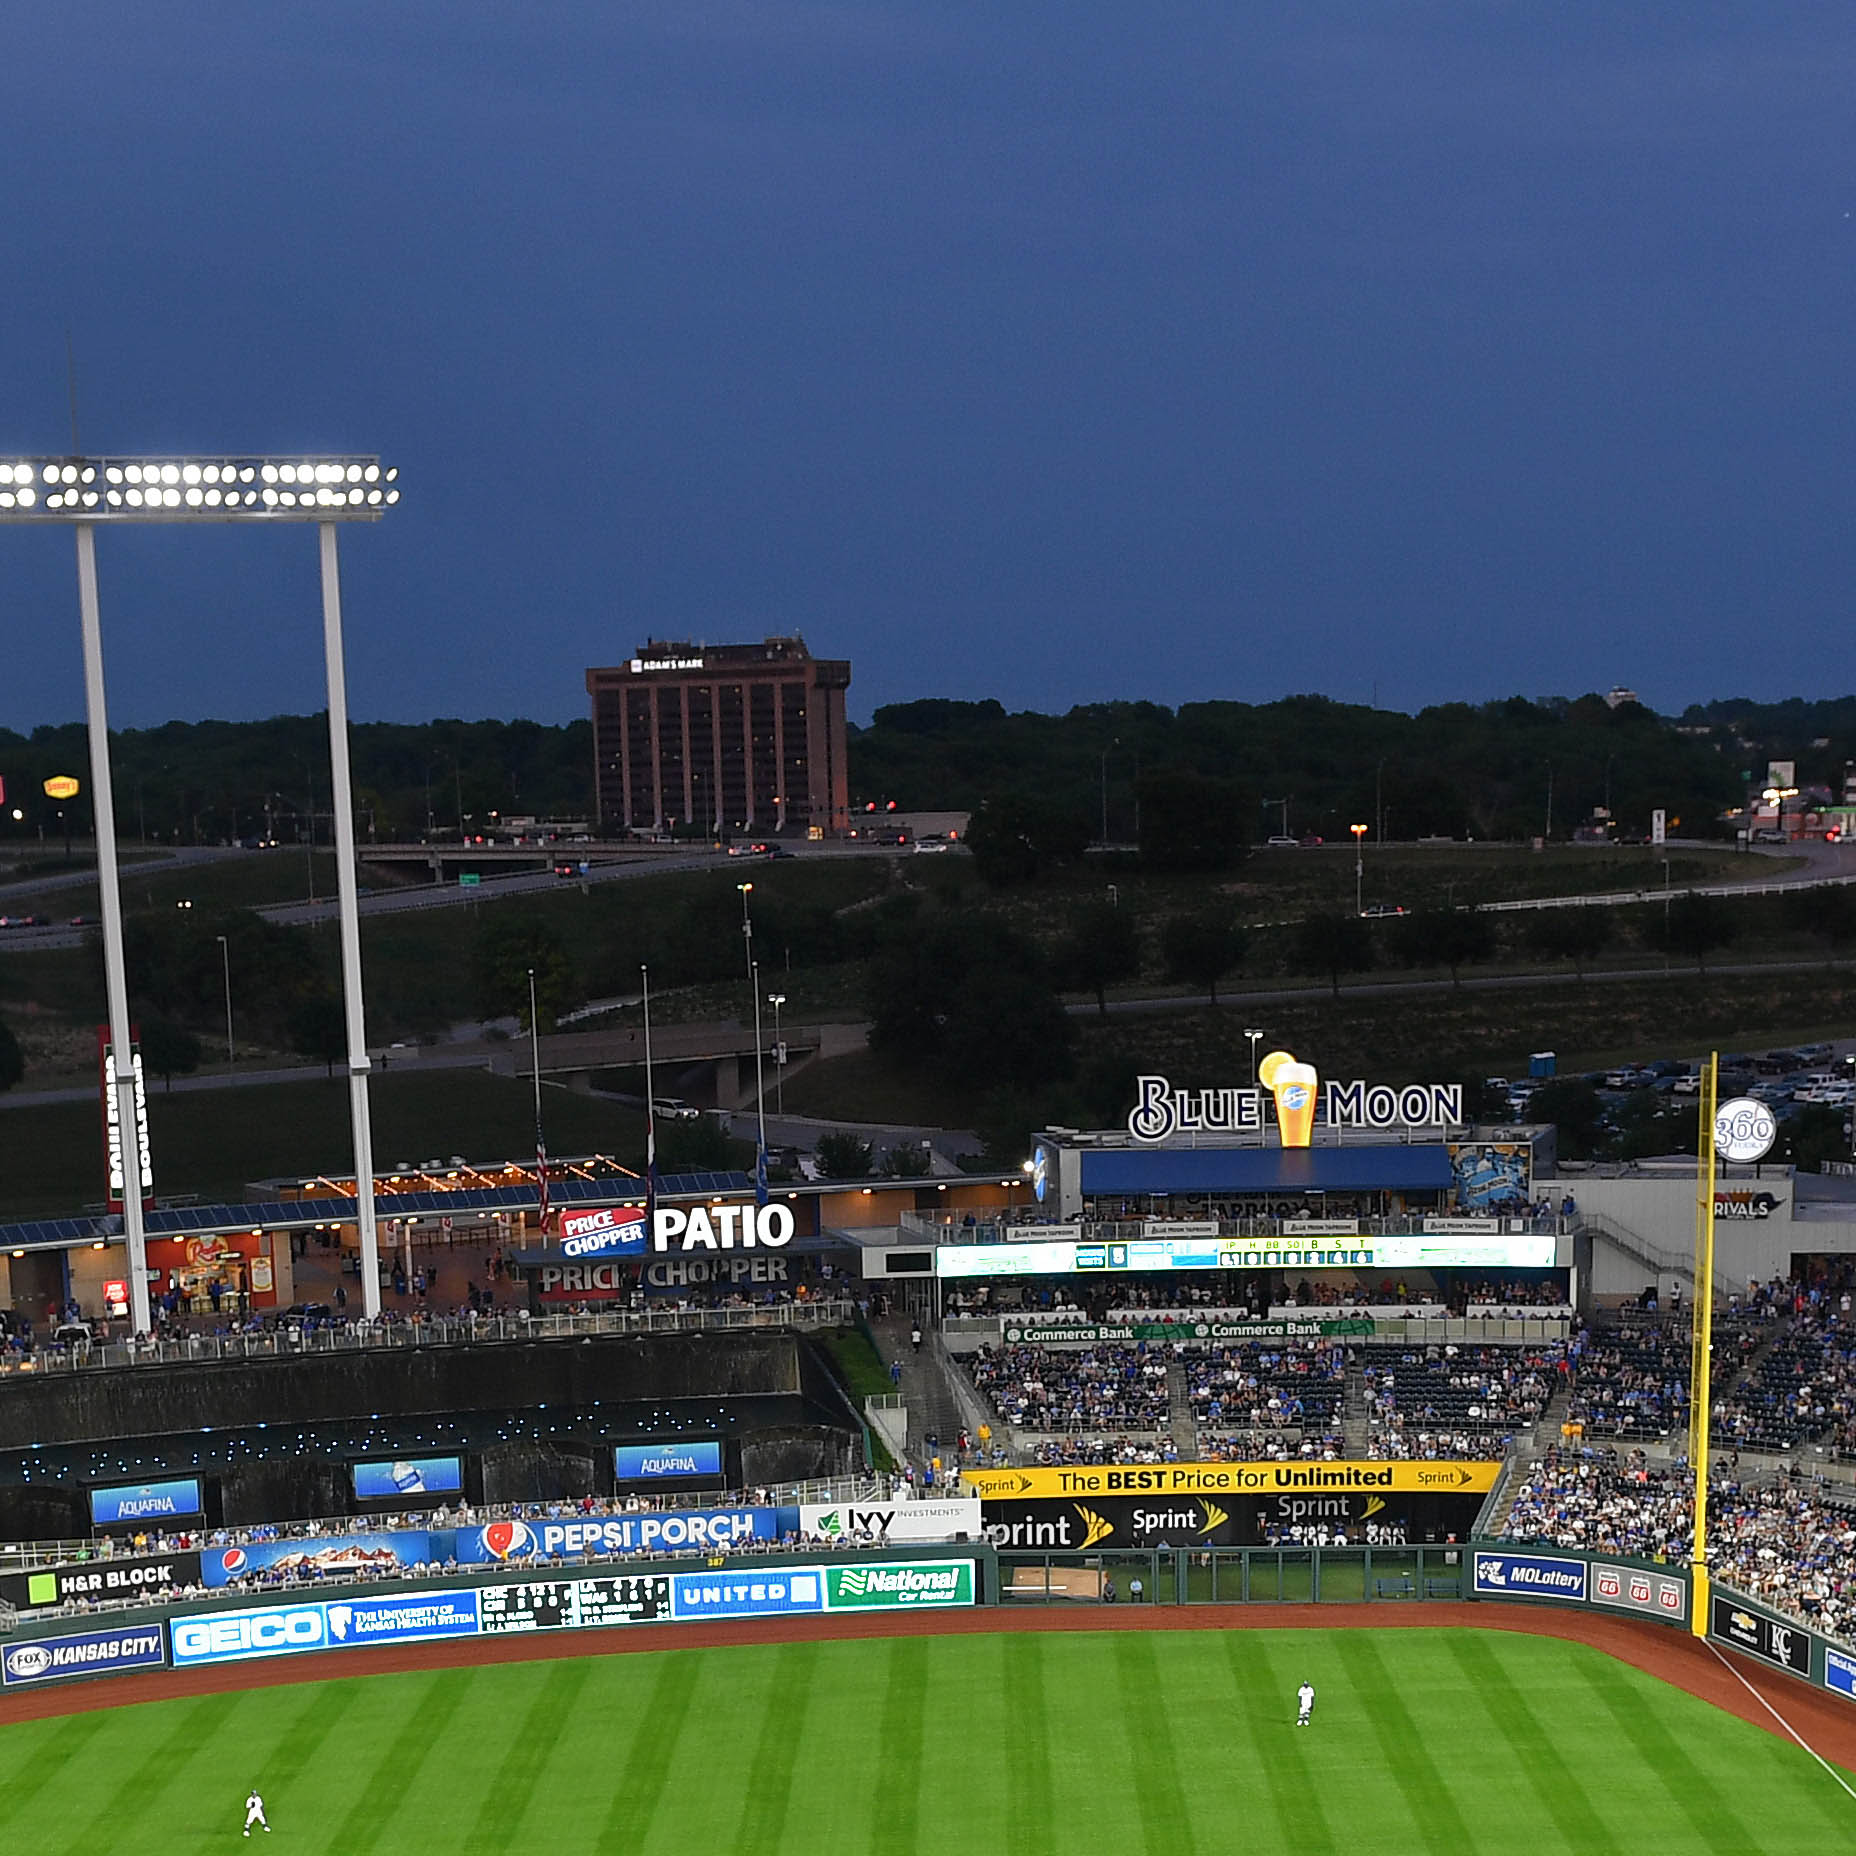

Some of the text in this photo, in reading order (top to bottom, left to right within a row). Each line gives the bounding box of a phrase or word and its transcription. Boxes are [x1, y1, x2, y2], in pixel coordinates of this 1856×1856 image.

[1129, 1075, 1462, 1142] BLUE MOON
[1714, 1110, 1774, 1149] 360
[1715, 1201, 1769, 1215] RIVALS
[564, 1224, 643, 1256] CHOPPER
[565, 1204, 794, 1252] PRICE PATIO
[1311, 1240, 1318, 1249] B
[1335, 1240, 1341, 1249] S
[1024, 1326, 1134, 1342] Commerce Bank
[1212, 1321, 1321, 1337] Commerce Bank
[641, 1456, 698, 1474] AQUAFINA
[978, 1467, 1454, 1493] Sprint The BEST Price for Unlimited Sprint
[117, 1496, 176, 1518] AQUAFINA
[1278, 1494, 1351, 1520] Sprint
[545, 1513, 754, 1552] PEPSI PORCH
[848, 1508, 961, 1536] Ivy INVESTMENTS
[1132, 1507, 1198, 1535] Sprint
[61, 1565, 173, 1595] H&R BLOCK
[865, 1567, 960, 1593] National
[1510, 1566, 1584, 1590] MOLottery
[684, 1583, 786, 1604] UNITED
[898, 1589, 956, 1602] Car Rental
[1601, 1581, 1677, 1607] 66 66 66
[355, 1604, 455, 1622] THE UNIVERSITY OF
[355, 1619, 396, 1634] KANSAS
[397, 1616, 436, 1631] HEALTH
[437, 1612, 475, 1627] SYSTEM
[174, 1611, 323, 1657] GEICO
[1771, 1624, 1792, 1665] KC
[16, 1635, 160, 1668] FOX KANSAS CITY
